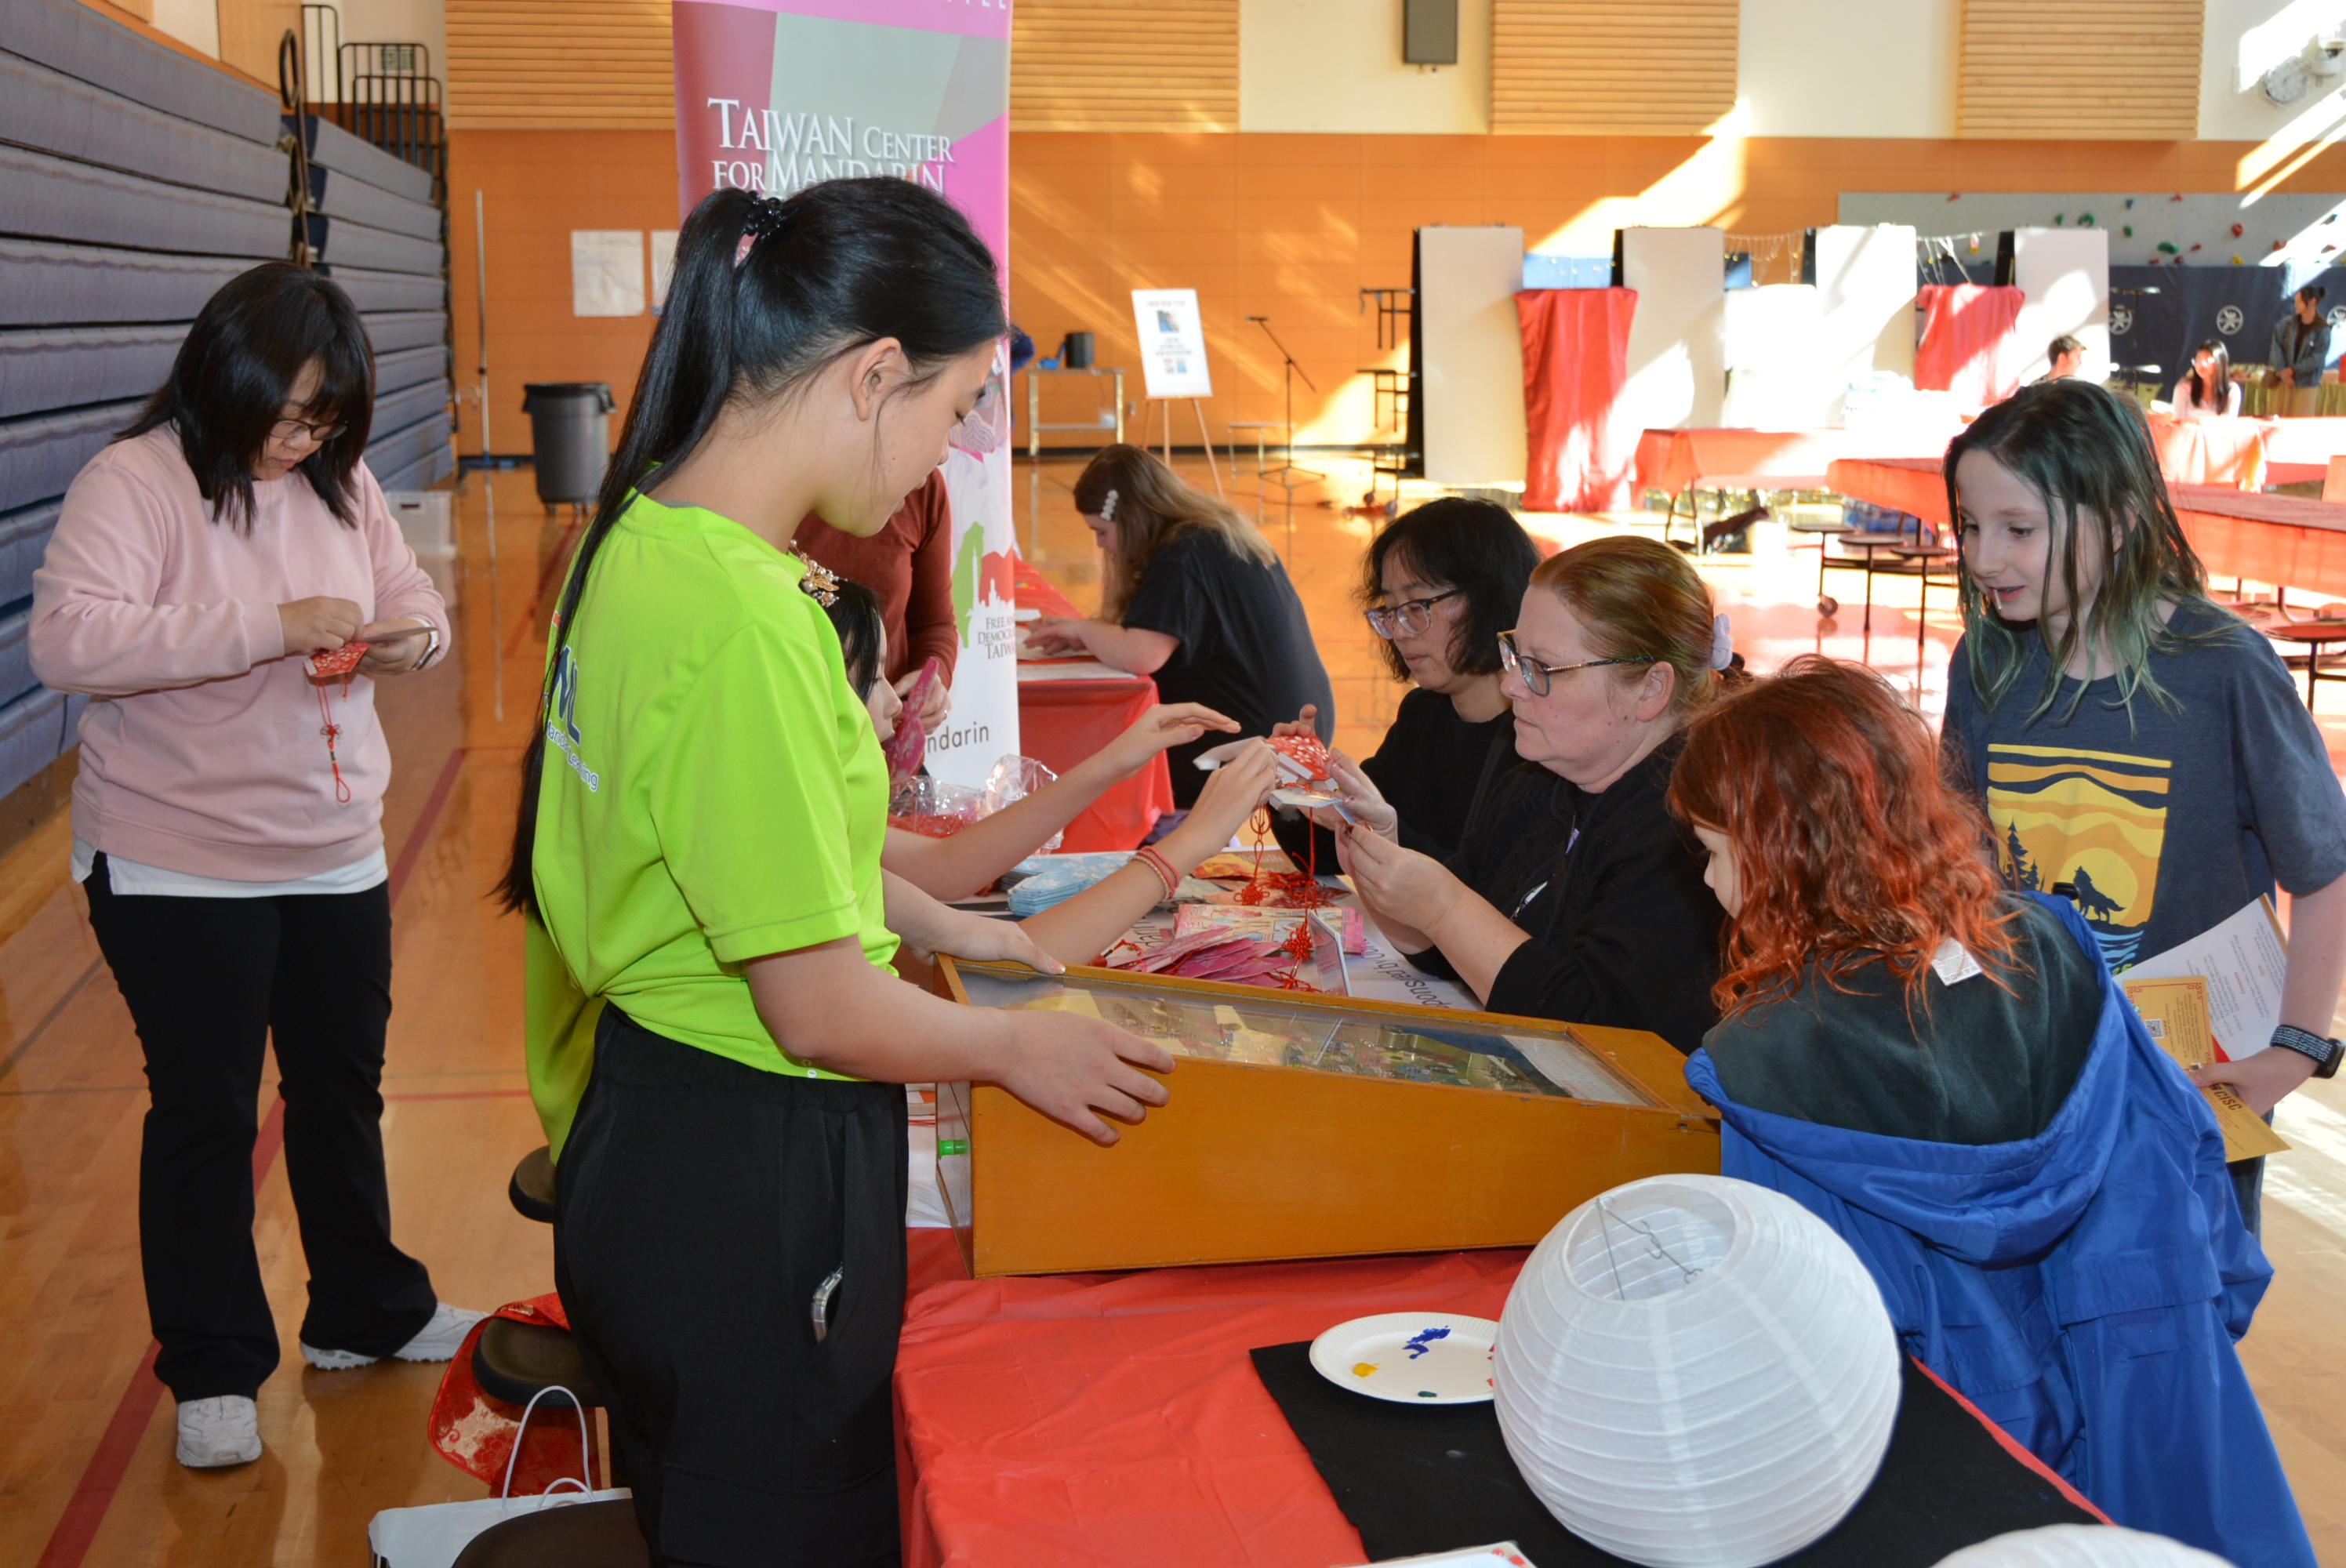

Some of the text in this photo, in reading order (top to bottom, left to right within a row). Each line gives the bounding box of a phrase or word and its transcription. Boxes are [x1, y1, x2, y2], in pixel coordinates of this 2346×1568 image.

[707, 97, 954, 162] TAIWAN CENTER
[712, 160, 766, 191] FOR
[986, 617, 1004, 630] FREE
[927, 720, 989, 753] ndarin
[2214, 1090, 2242, 1111] CISC
